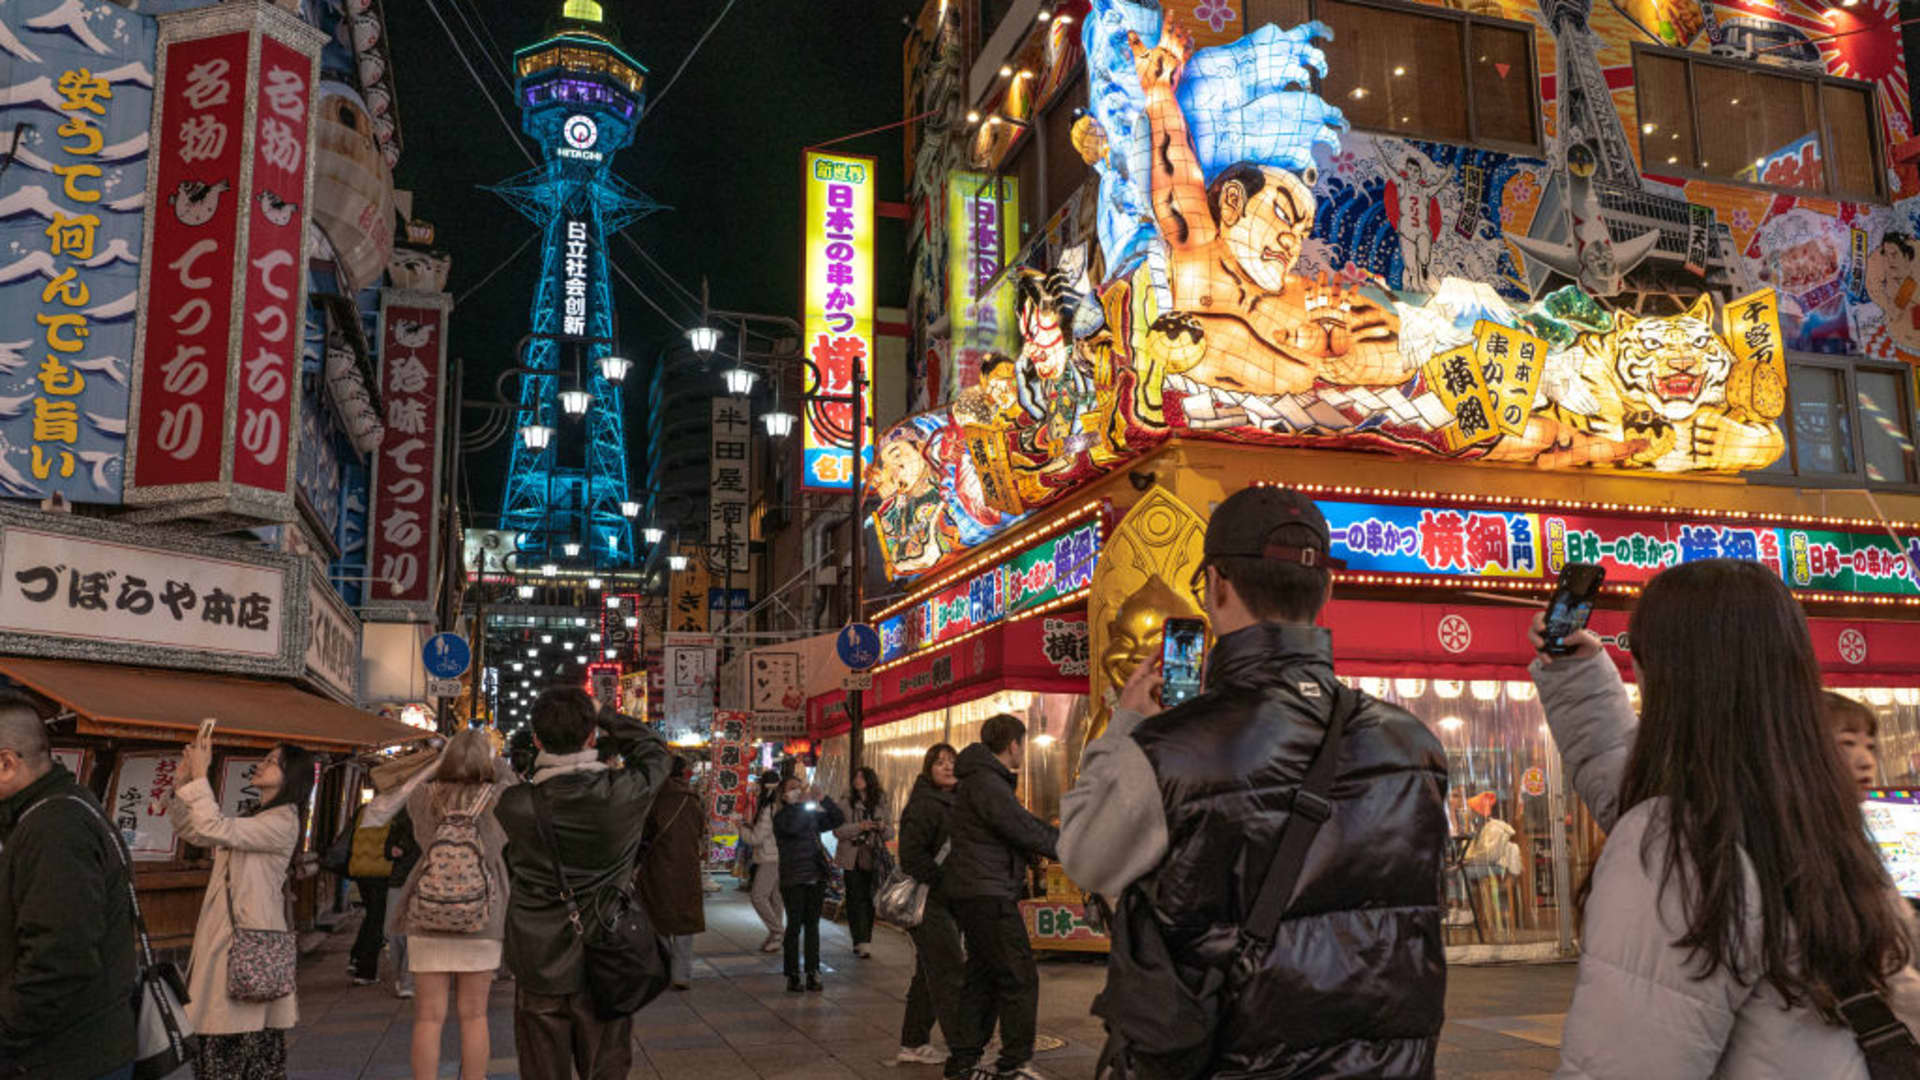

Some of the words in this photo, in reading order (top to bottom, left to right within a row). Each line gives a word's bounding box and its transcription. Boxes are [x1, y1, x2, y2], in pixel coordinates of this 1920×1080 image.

[176, 58, 231, 164] 名物
[259, 65, 306, 174] 名物
[557, 148, 603, 161] HITACHI
[825, 184, 855, 333] 日本一の串かつ
[157, 239, 219, 460] てっちり
[242, 249, 296, 466] てっちり
[1505, 342, 1534, 424] 日本一の
[1441, 355, 1489, 439] 横綱
[713, 406, 748, 564] 半田屋酒店
[1419, 510, 1508, 569] 横綱
[1509, 517, 1534, 571] 名門
[1567, 531, 1678, 567] 日本一の串かつ
[1809, 544, 1909, 577] 日本一の串かつ
[15, 563, 272, 631] づぼらや本店
[1037, 907, 1104, 937] 日本一
